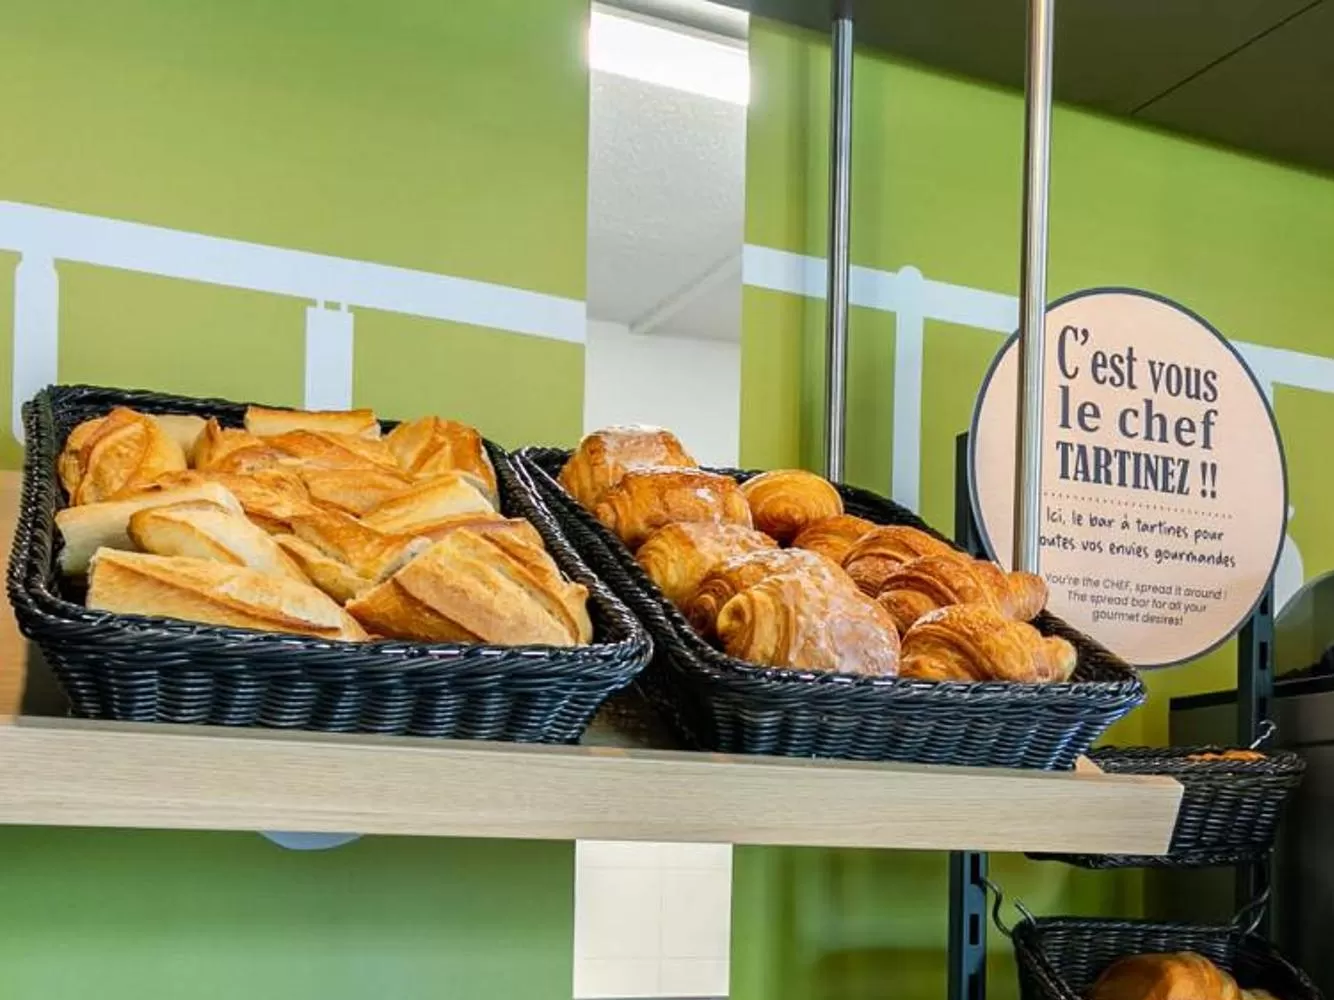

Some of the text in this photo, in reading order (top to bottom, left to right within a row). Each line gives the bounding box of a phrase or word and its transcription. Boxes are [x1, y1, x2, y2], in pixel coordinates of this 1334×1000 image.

[1057, 324, 1218, 402] C'est vous
[1059, 385, 1218, 449] le chef
[1056, 440, 1218, 498] TARTINEZ !!
[1046, 506, 1066, 524] Ici,
[1072, 510, 1082, 525] le
[1089, 512, 1115, 528] bar
[1135, 518, 1189, 539] tartines
[1194, 529, 1225, 543] pour
[1040, 533, 1236, 568] outes vos envies gourmandes
[1067, 590, 1207, 614] The spread bar for all your
[1082, 575, 1100, 588] the
[1135, 582, 1172, 597] spread
[1183, 587, 1222, 600] around
[1092, 609, 1140, 622] gourmet
